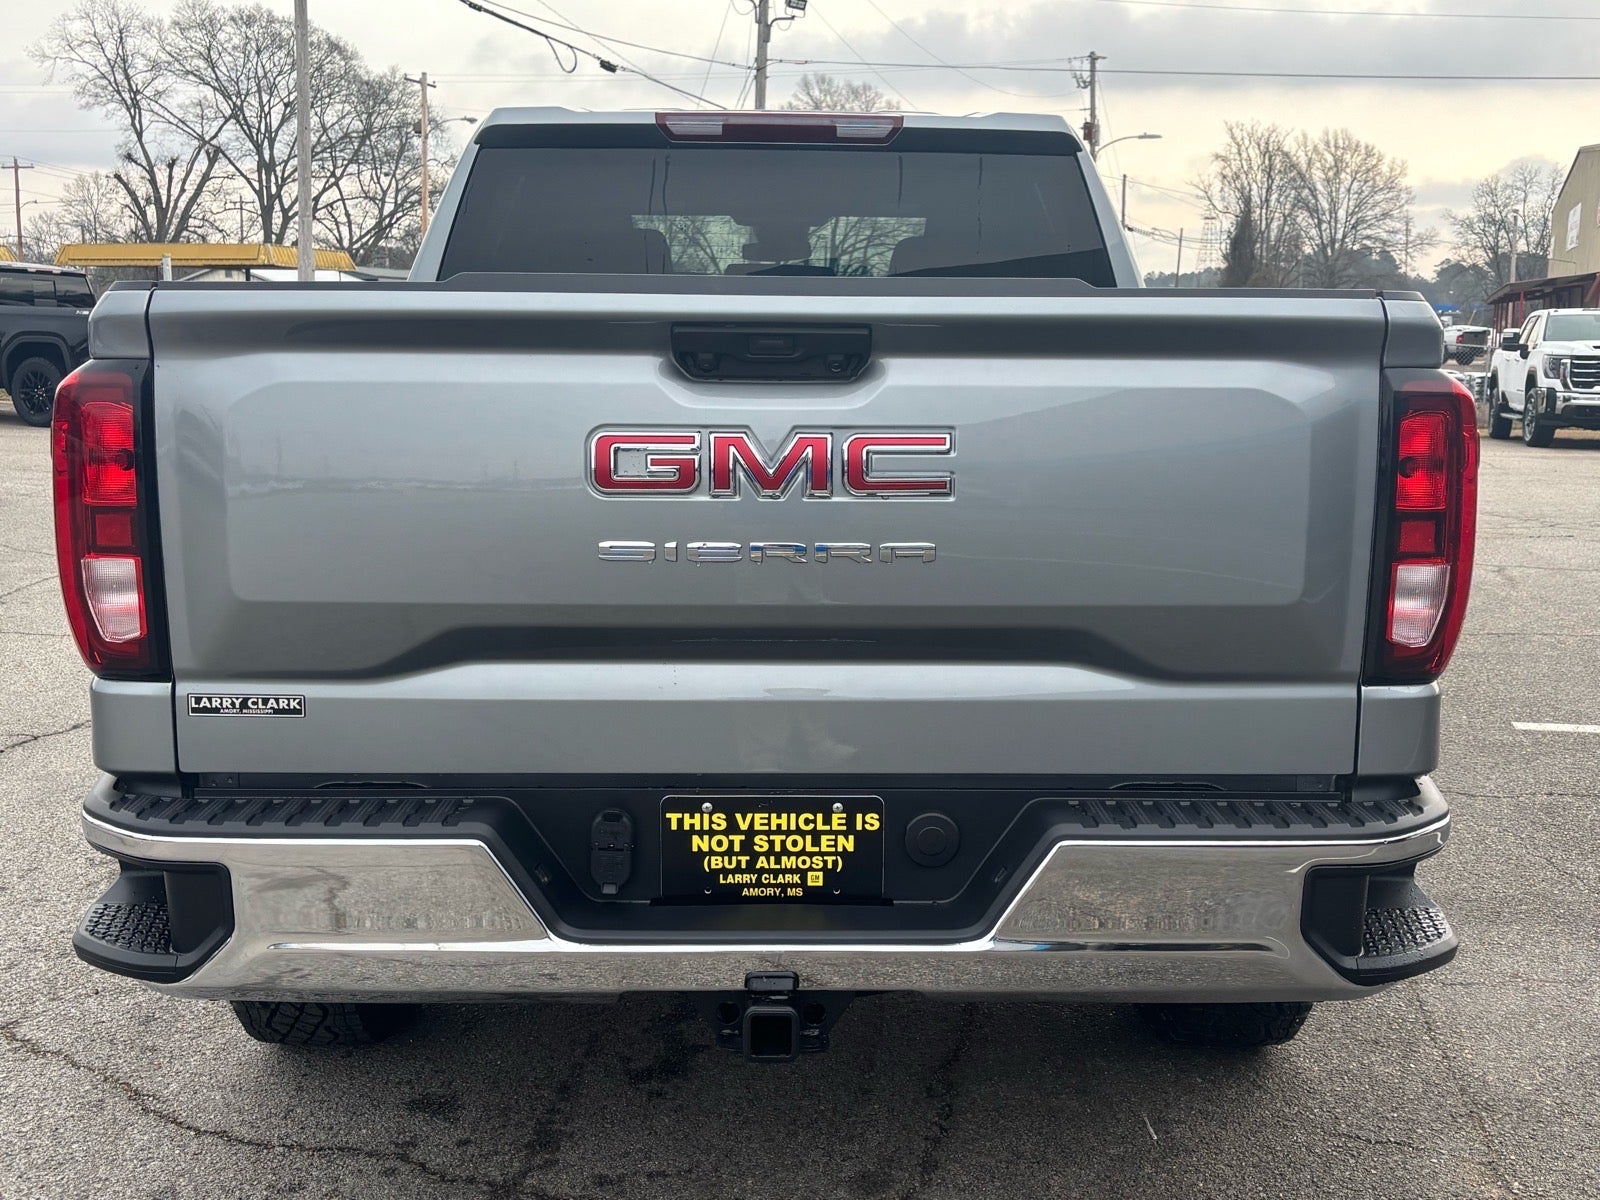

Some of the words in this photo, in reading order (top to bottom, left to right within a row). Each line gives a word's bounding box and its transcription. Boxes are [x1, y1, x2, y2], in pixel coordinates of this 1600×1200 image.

[590, 430, 953, 499] GMC
[598, 540, 936, 563] SIERRA
[191, 697, 243, 709] LARRY
[247, 698, 301, 710] CLARK
[665, 813, 727, 830] THIS
[735, 813, 847, 831] VEHICLE
[855, 813, 881, 831] IS
[692, 835, 745, 852] NOT
[753, 835, 855, 852] STOLEN
[703, 856, 750, 872] (BUT
[756, 856, 843, 872] ALMOST)
[719, 874, 757, 884] LARRY
[761, 873, 801, 884] CLARK
[742, 888, 784, 898] AMORY,
[787, 888, 804, 897] MS
